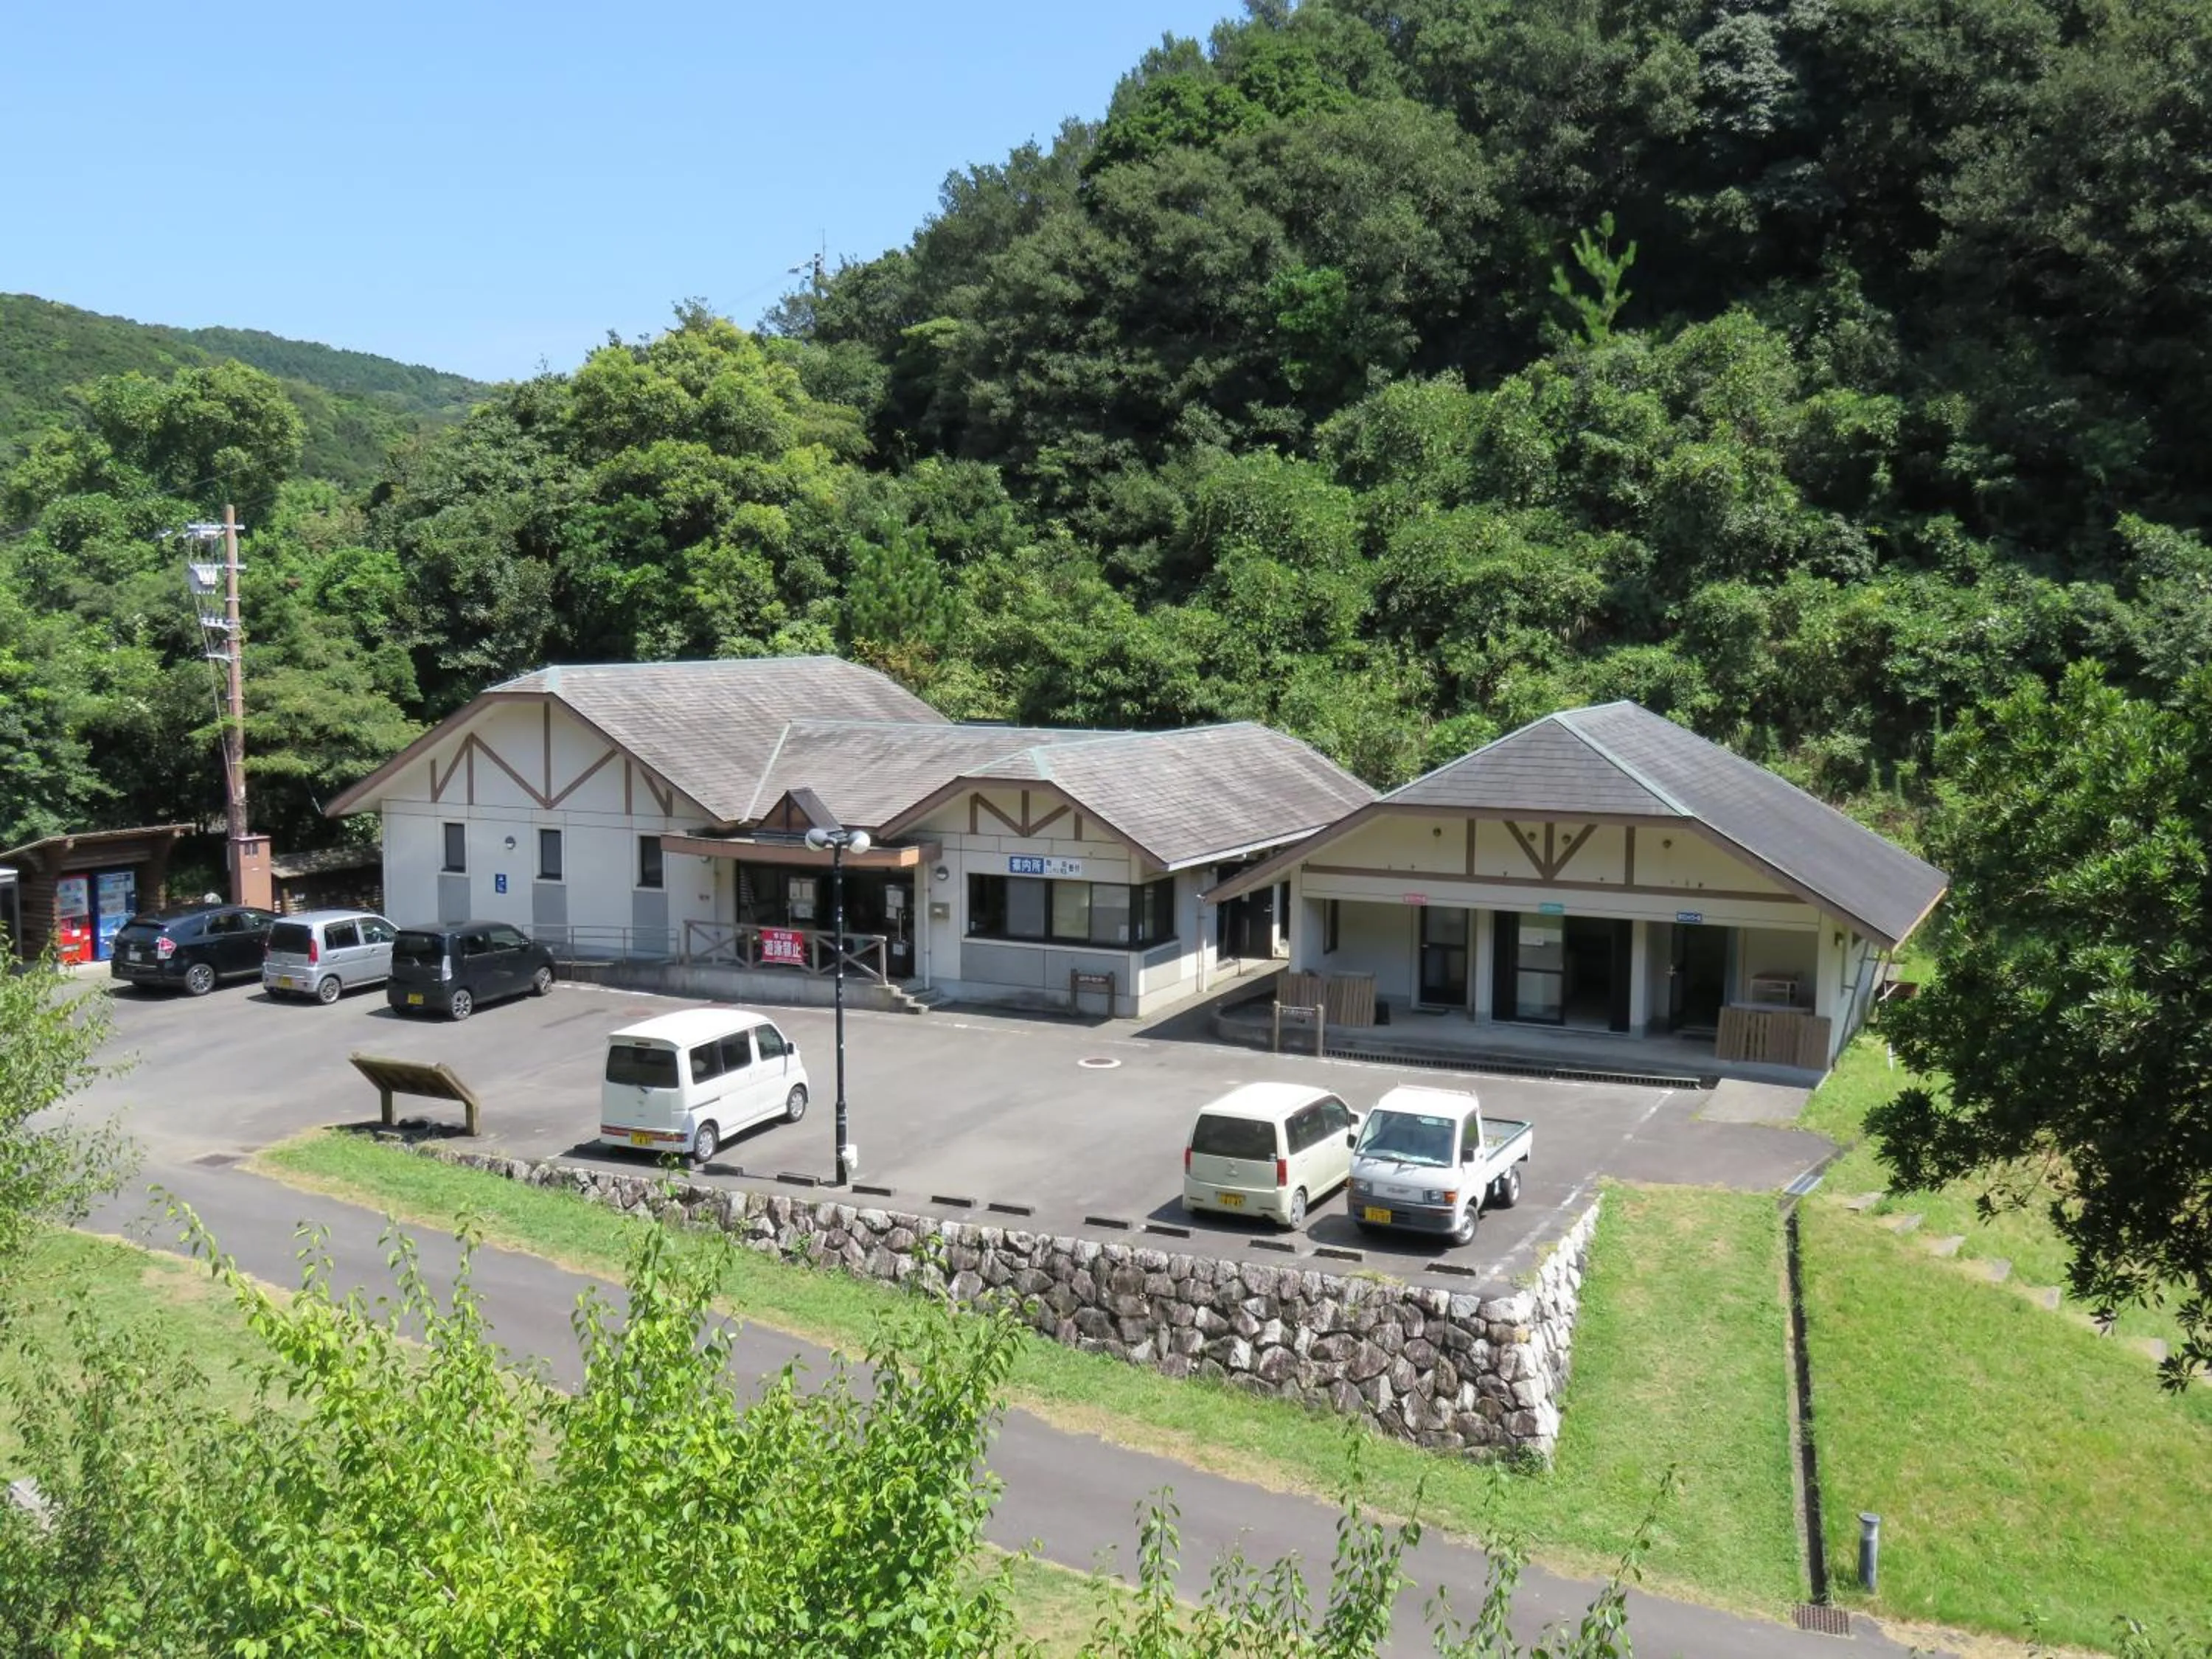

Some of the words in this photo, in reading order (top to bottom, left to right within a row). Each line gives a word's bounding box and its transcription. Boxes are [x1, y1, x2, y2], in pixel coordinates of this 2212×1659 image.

[1012, 858, 1042, 872] 案内所
[764, 940, 801, 958] 遊泳禁止
